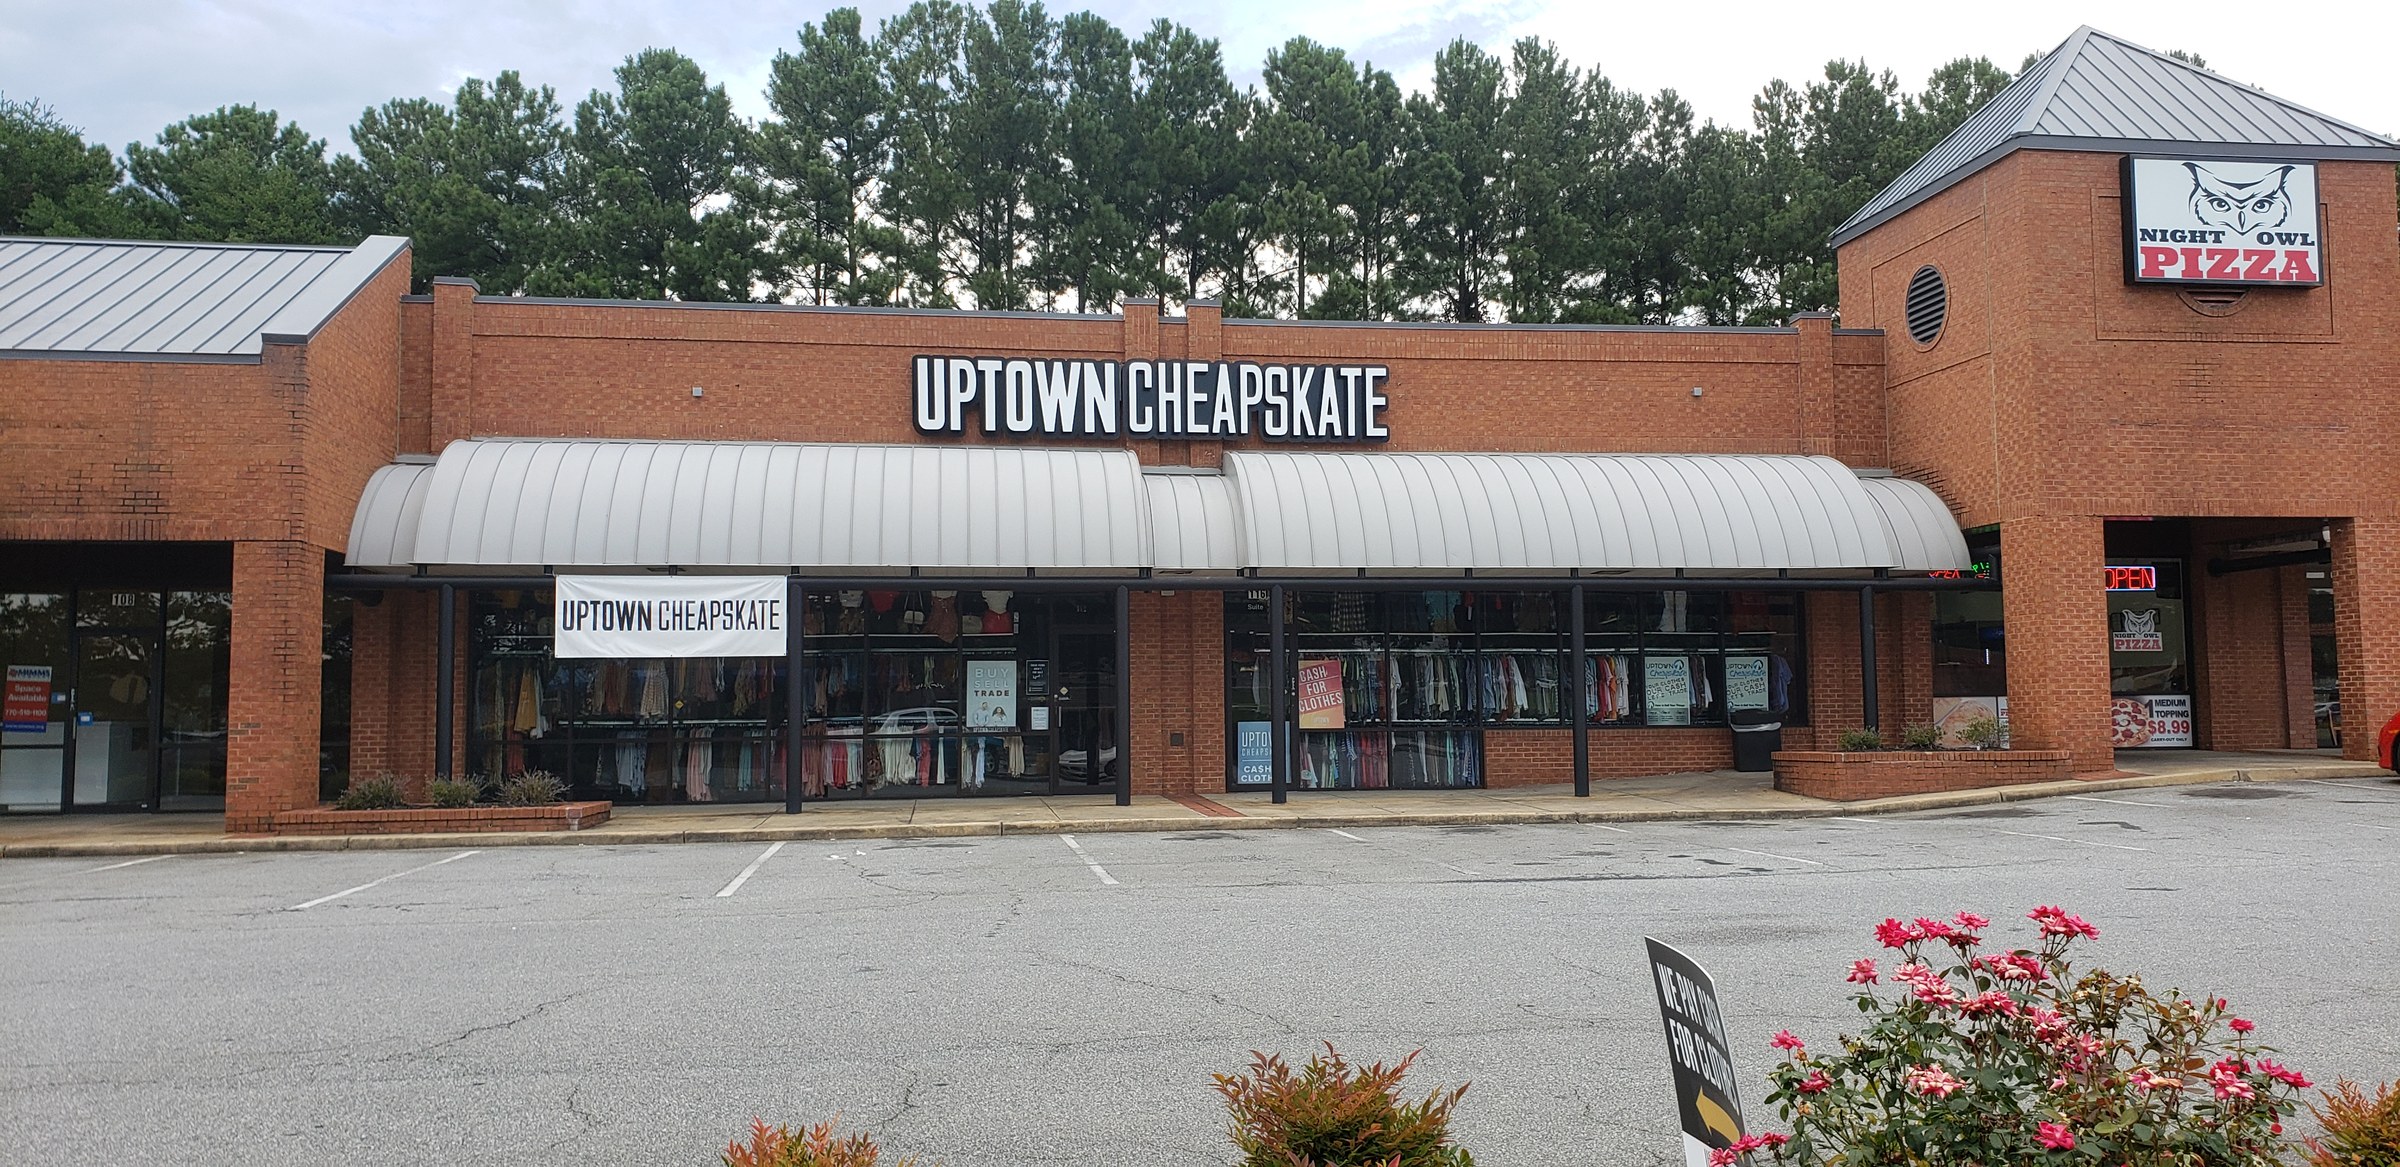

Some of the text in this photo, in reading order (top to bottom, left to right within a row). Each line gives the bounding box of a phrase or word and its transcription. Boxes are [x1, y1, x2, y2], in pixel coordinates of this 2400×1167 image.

[2139, 228, 2315, 246] NIGHT OWL
[2139, 245, 2317, 282] PIZZA
[916, 357, 1389, 437] UPTOWN CHEAPSKATE
[2104, 567, 2154, 589] OPEN
[111, 593, 135, 606] 108
[562, 599, 781, 631] UPTOWN CHEAPSKATE
[2114, 639, 2162, 650] PIZZA
[18, 668, 50, 678] MIMMS
[975, 668, 1010, 678] BUY
[1300, 666, 1327, 683] CASH
[974, 680, 1009, 689] SELL
[1660, 677, 1685, 686] CLOTHES
[1665, 682, 1687, 691] CASH
[1740, 677, 1764, 686] CLOTHES
[1744, 682, 1766, 691] CASH
[15, 684, 42, 693] Space
[974, 689, 1010, 697] TRADE
[1306, 681, 1327, 696] FOR
[8, 693, 47, 703] Available
[1299, 692, 1343, 712] CLOTHES
[2154, 699, 2187, 707] MEDIUM
[2144, 699, 2154, 719] 1
[2154, 710, 2190, 718] TOPPING
[2147, 720, 2190, 735] $8.99
[1241, 731, 1272, 747] UPTO
[1241, 748, 1272, 757] CHEAPS
[1241, 774, 1272, 782] CLOTH
[1656, 962, 1682, 1014] WE
[1675, 971, 1703, 1027] PAY
[1669, 1018, 1701, 1074] FOR
